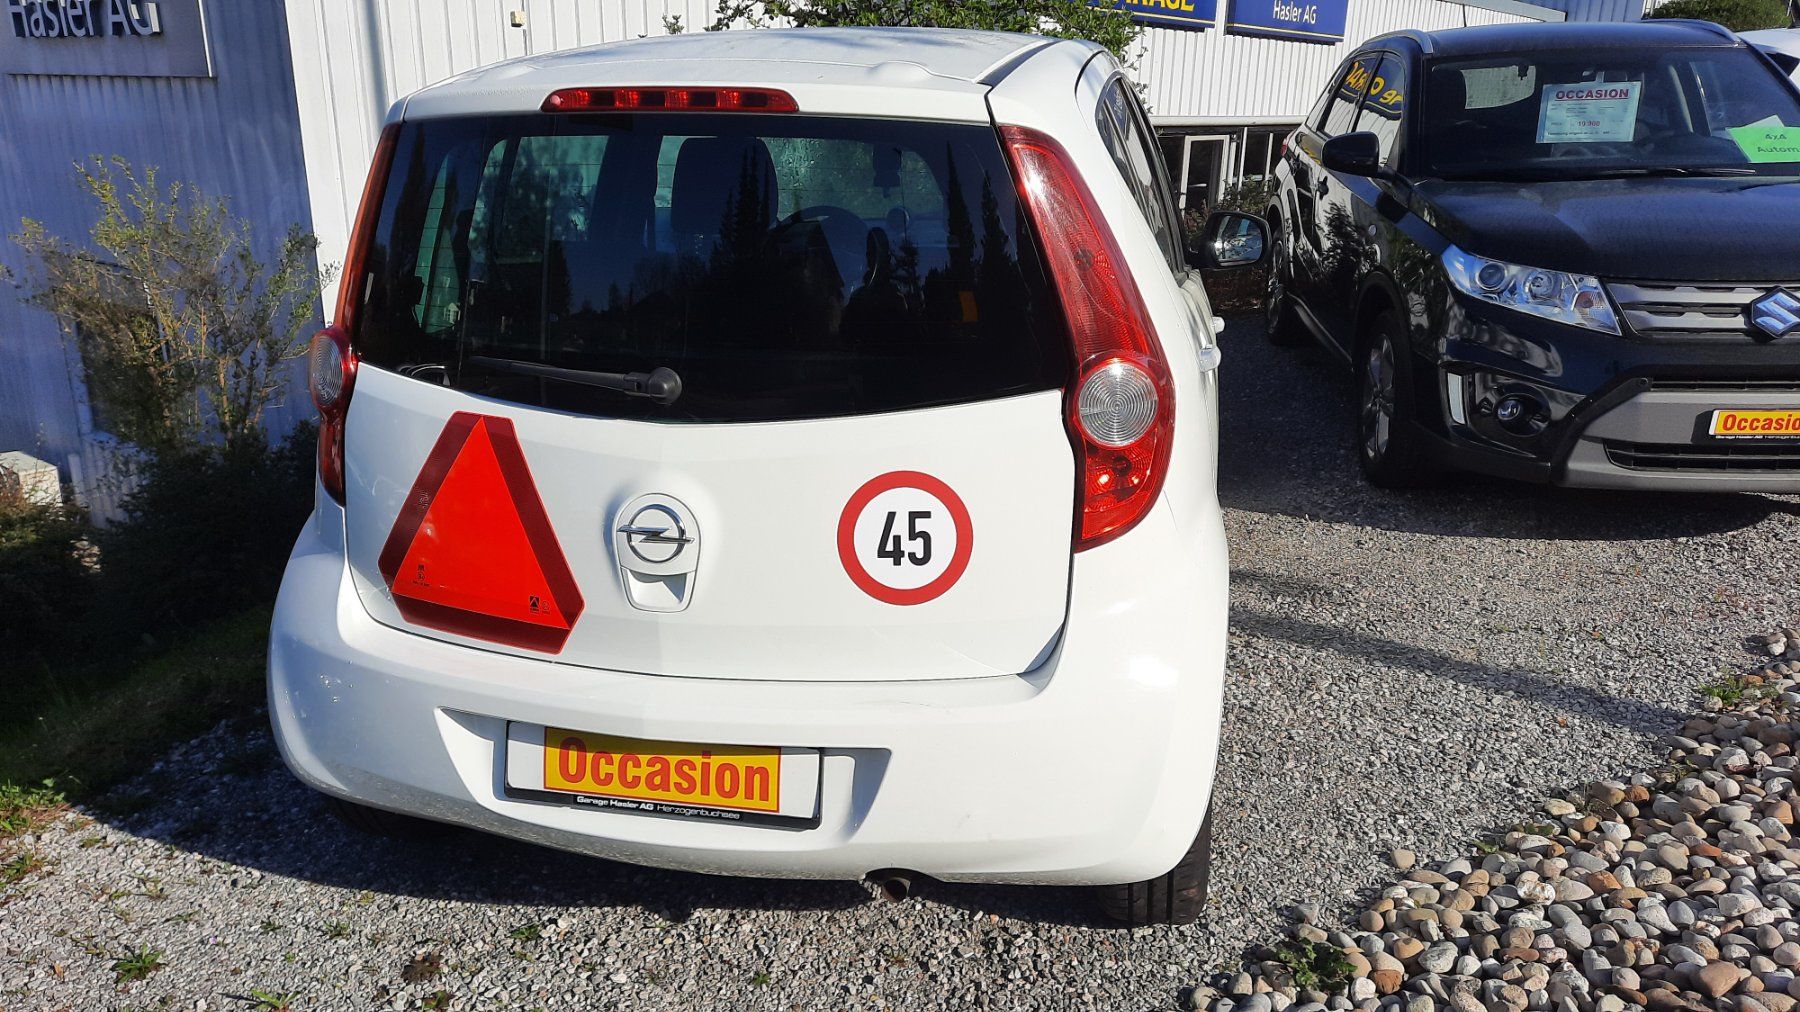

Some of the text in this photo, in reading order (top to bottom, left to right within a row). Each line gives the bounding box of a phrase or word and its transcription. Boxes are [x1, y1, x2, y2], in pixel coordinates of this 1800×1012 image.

[1272, 0, 1317, 24] Hasler AG
[1555, 89, 1629, 99] OCCASION
[877, 511, 932, 566] 45
[559, 736, 770, 802] Occasion
[577, 796, 740, 819] Garage Hasler AG Herzogenbuchsee
